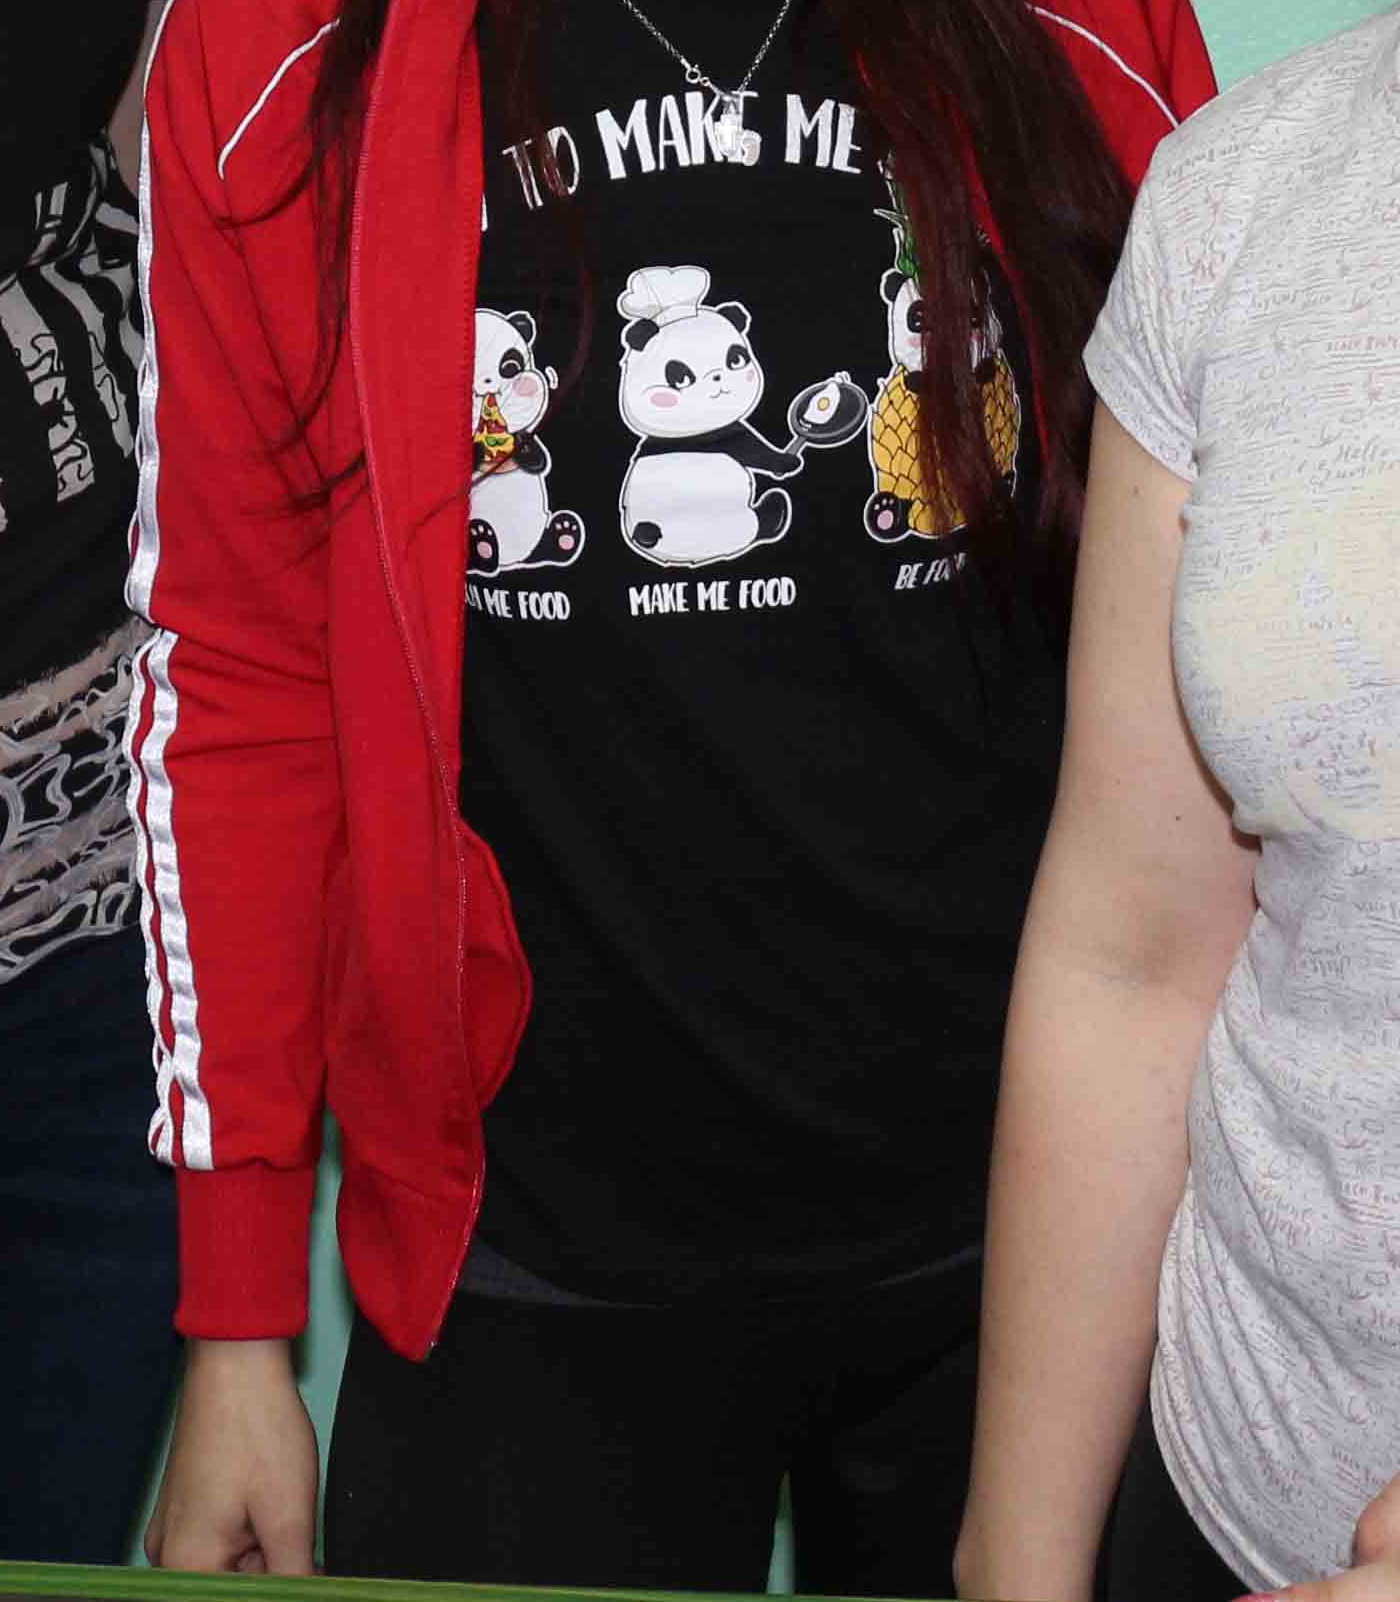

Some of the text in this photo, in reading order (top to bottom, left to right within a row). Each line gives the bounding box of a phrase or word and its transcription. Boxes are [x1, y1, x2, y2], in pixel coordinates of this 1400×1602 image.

[595, 90, 760, 181] MAKE
[784, 92, 862, 175] ME
[894, 552, 967, 591] BE FO
[482, 588, 513, 619] ME
[517, 590, 571, 621] FOOD
[628, 575, 797, 617] MAKE ME FOOD
